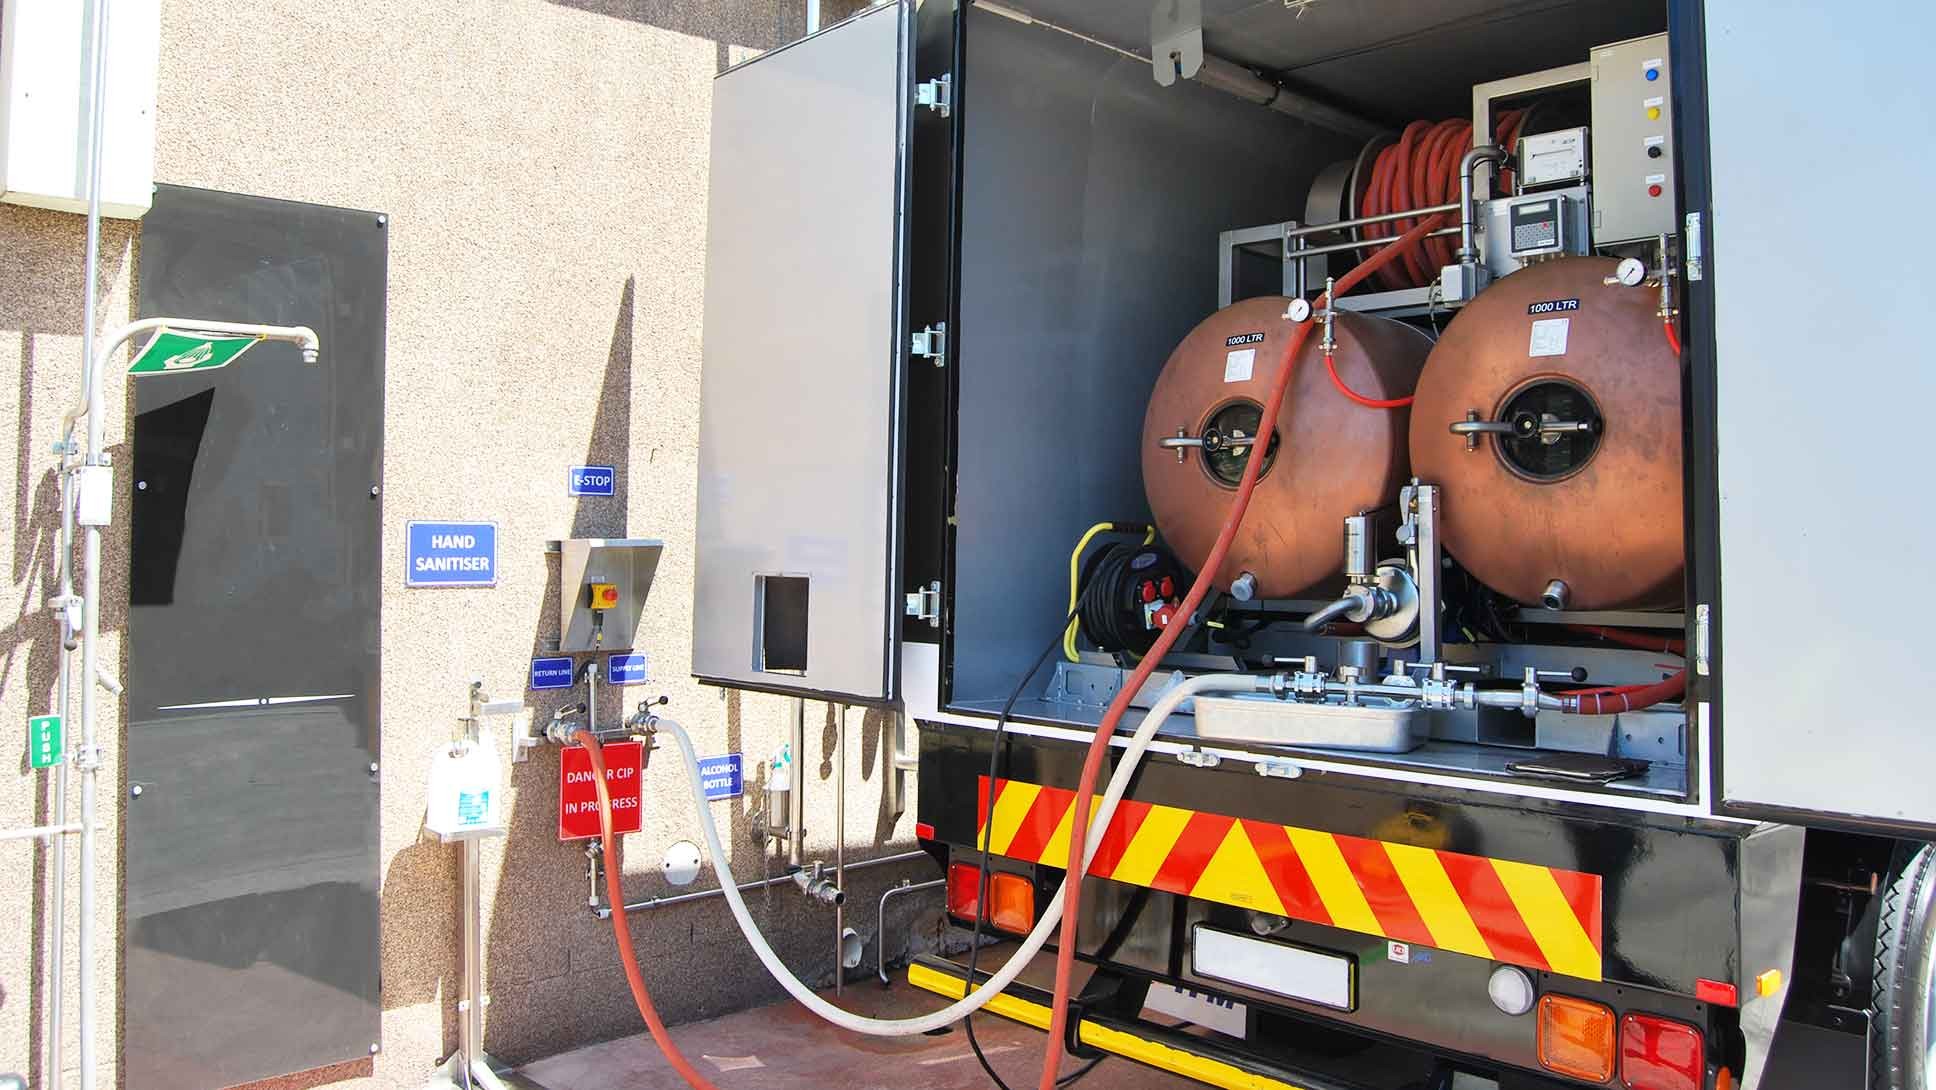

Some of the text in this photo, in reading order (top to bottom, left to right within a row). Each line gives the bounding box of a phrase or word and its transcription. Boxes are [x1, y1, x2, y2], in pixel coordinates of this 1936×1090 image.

[1530, 300, 1577, 313] 1000 LTR
[1228, 333, 1263, 345] 1000 LTR
[574, 475, 610, 486] E-STOP
[431, 534, 476, 549] HAND
[415, 556, 490, 572] SANITISER
[534, 669, 558, 678] RETURN
[41, 720, 52, 764] PUSH
[567, 767, 634, 784] DANR CIP
[700, 763, 739, 777] ALCOHOL
[703, 777, 733, 790] BOTTLE
[565, 796, 638, 815] IN PRRESS
